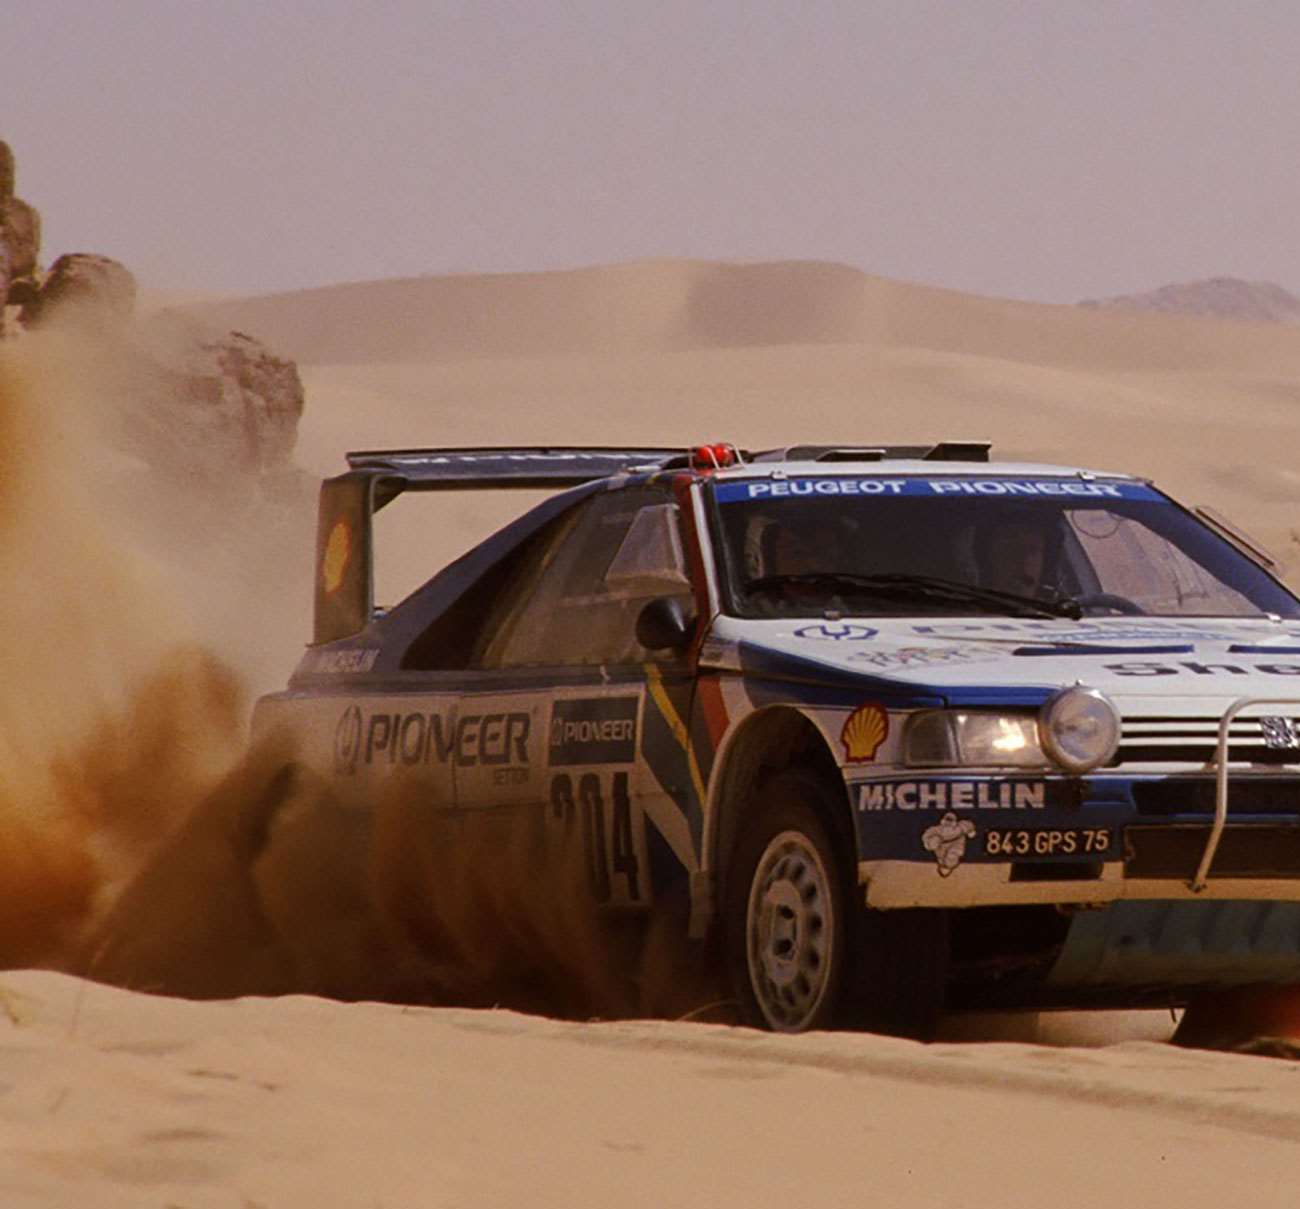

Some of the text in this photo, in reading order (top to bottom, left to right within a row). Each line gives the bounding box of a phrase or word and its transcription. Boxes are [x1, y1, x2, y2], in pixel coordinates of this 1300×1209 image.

[748, 480, 1124, 498] PEUGEOT PIONEER
[365, 710, 531, 768] PIONEER
[564, 719, 633, 743] PIONEER
[859, 782, 1046, 811] MICHELIN
[986, 829, 1109, 855] 843 GPS 75
